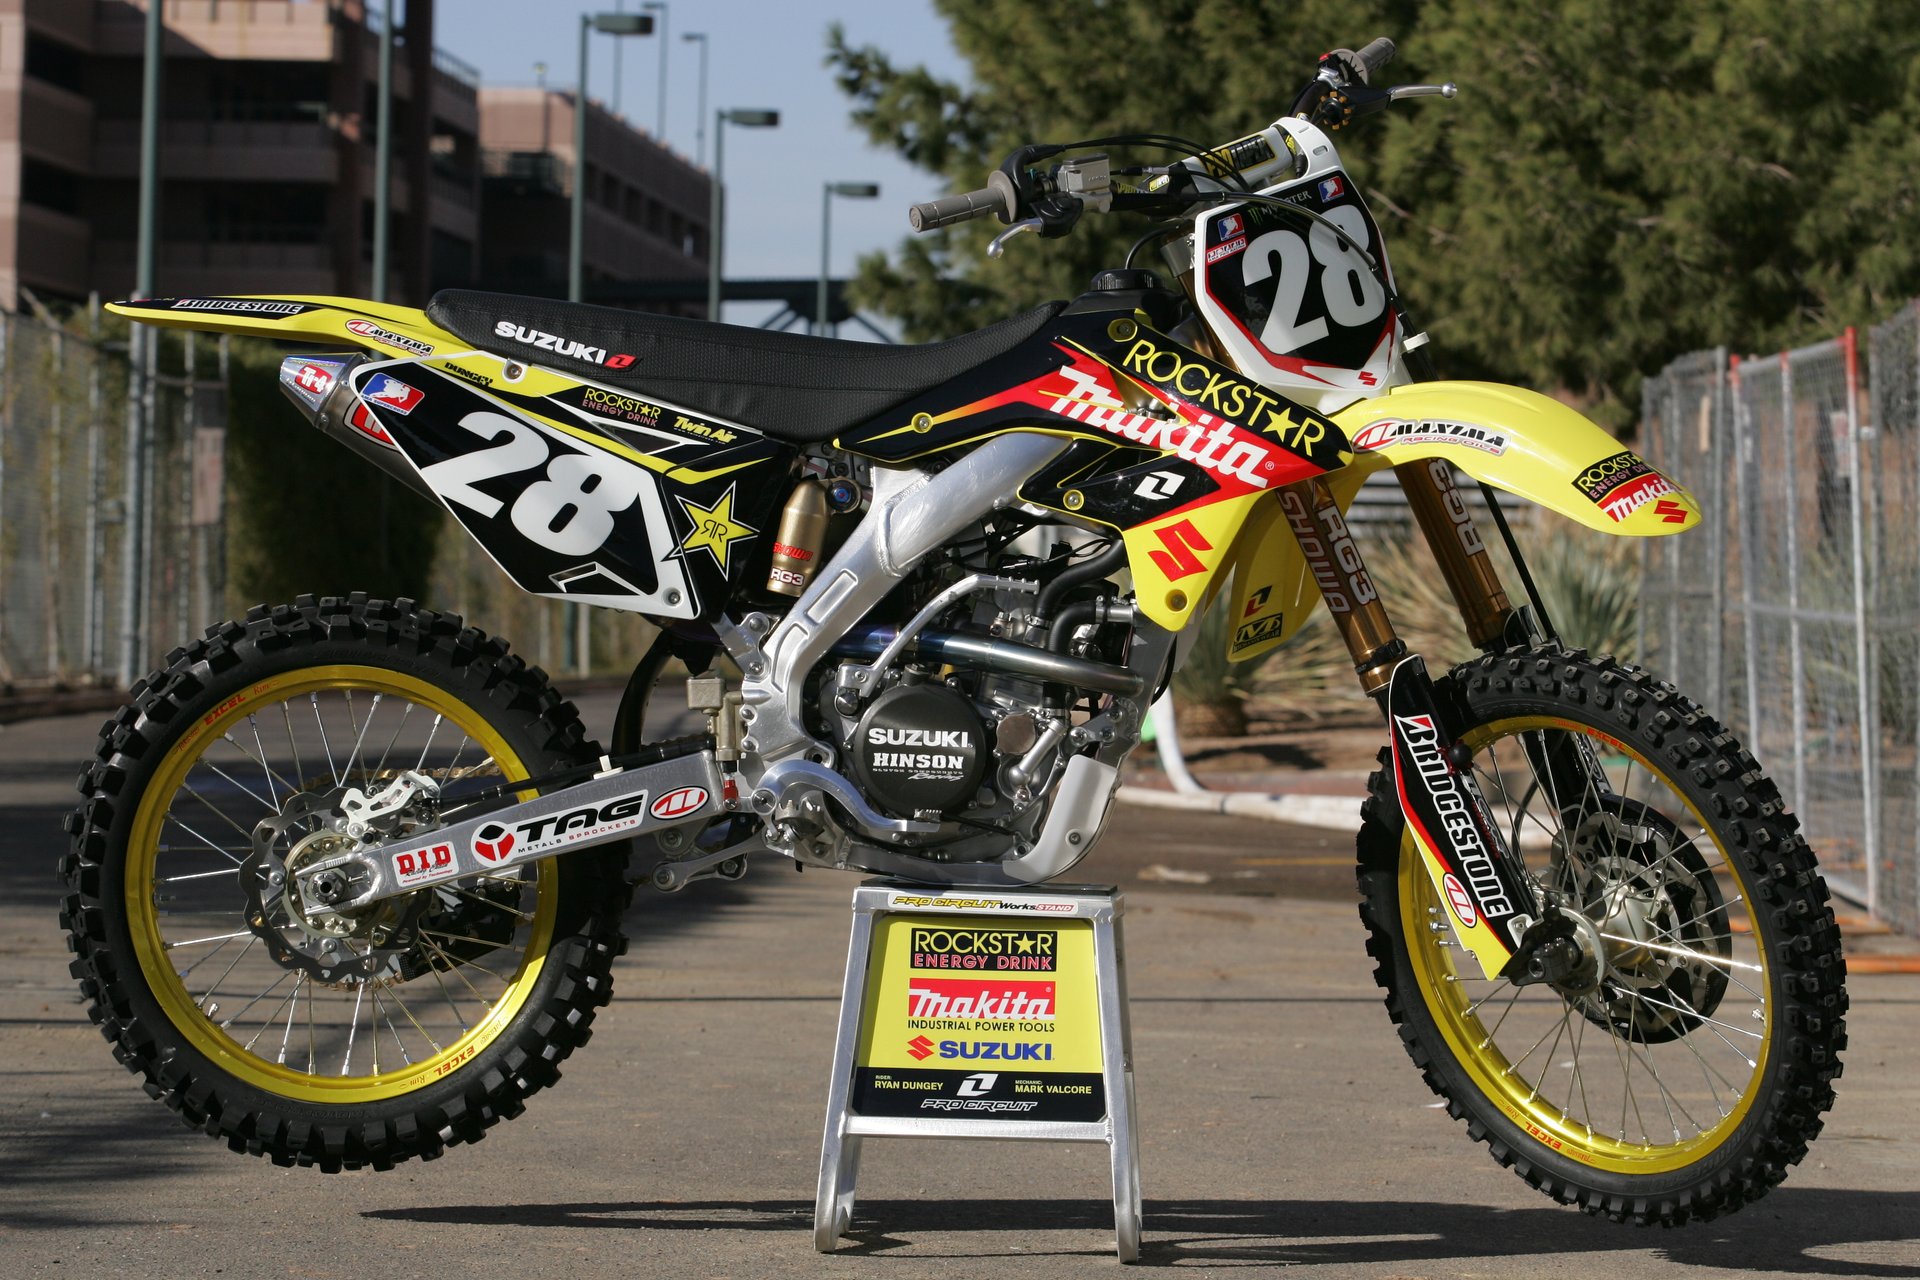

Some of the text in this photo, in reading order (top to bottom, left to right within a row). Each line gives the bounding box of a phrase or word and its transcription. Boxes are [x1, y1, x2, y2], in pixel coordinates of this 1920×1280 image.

[1242, 204, 1385, 355] 28
[171, 299, 305, 315] BRIDGESTONE
[494, 321, 606, 365] SUZUKI
[444, 362, 494, 388] DUNGEY
[582, 399, 659, 428] ENERGY DRINK
[674, 416, 709, 437] Twin
[708, 428, 738, 444] Air
[421, 411, 639, 556] 28
[1589, 468, 1632, 499] ENERGY
[1427, 458, 1485, 557] RG3
[1279, 491, 1352, 613] SHOWA
[1317, 505, 1379, 606] RG3
[770, 568, 804, 586] RG3
[204, 695, 247, 726] EXCEL
[868, 728, 969, 748] SUZUKI
[873, 752, 964, 770] HINSON
[516, 794, 644, 843] TAG
[1393, 714, 1514, 918] BRIDGESTONE
[518, 819, 636, 853] METALS SPROCKETS
[893, 896, 932, 906] PRO
[932, 898, 1002, 909] CIRCUIT
[914, 953, 1052, 970] ENERGY DRINK
[908, 1020, 1055, 1033] INDUSTRIAL POWER TOOLS
[434, 1045, 475, 1077] EXCEL
[939, 1040, 1052, 1061] SUZUKI
[874, 1080, 943, 1091] RYAN DUNGEY
[1015, 1084, 1092, 1094] MARK VALCORE
[920, 1098, 1038, 1112] PRO CIRCUIT
[1525, 1121, 1563, 1151] EXCEL
